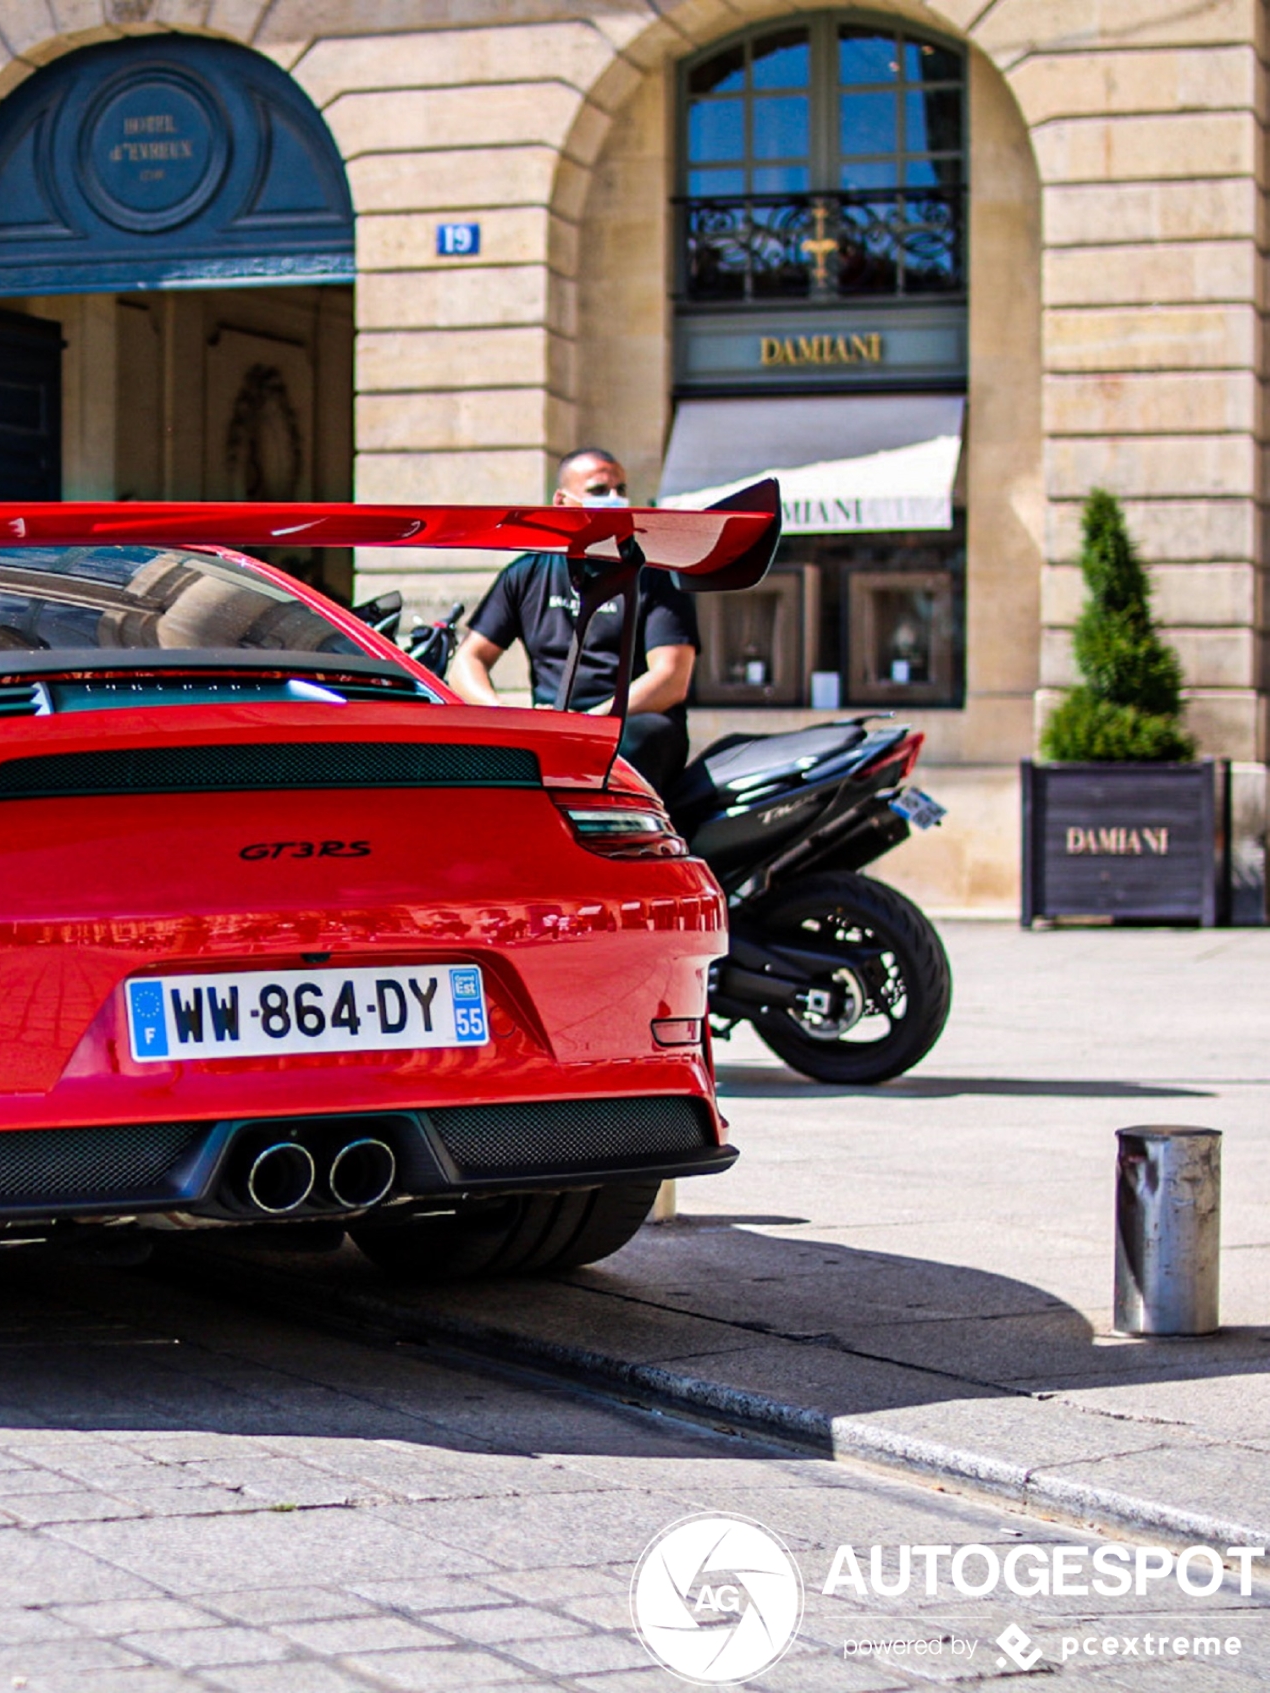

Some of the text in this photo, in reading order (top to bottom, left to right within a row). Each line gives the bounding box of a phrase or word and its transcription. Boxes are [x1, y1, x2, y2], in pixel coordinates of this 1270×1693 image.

[445, 227, 472, 252] 19
[760, 332, 881, 366] DAMIANI
[781, 498, 863, 525] MIANI
[1066, 827, 1170, 856] DAMIANI
[455, 981, 476, 994] Est
[170, 977, 439, 1044] WW-864-DY
[456, 1007, 483, 1036] 55
[144, 1027, 157, 1046] F
